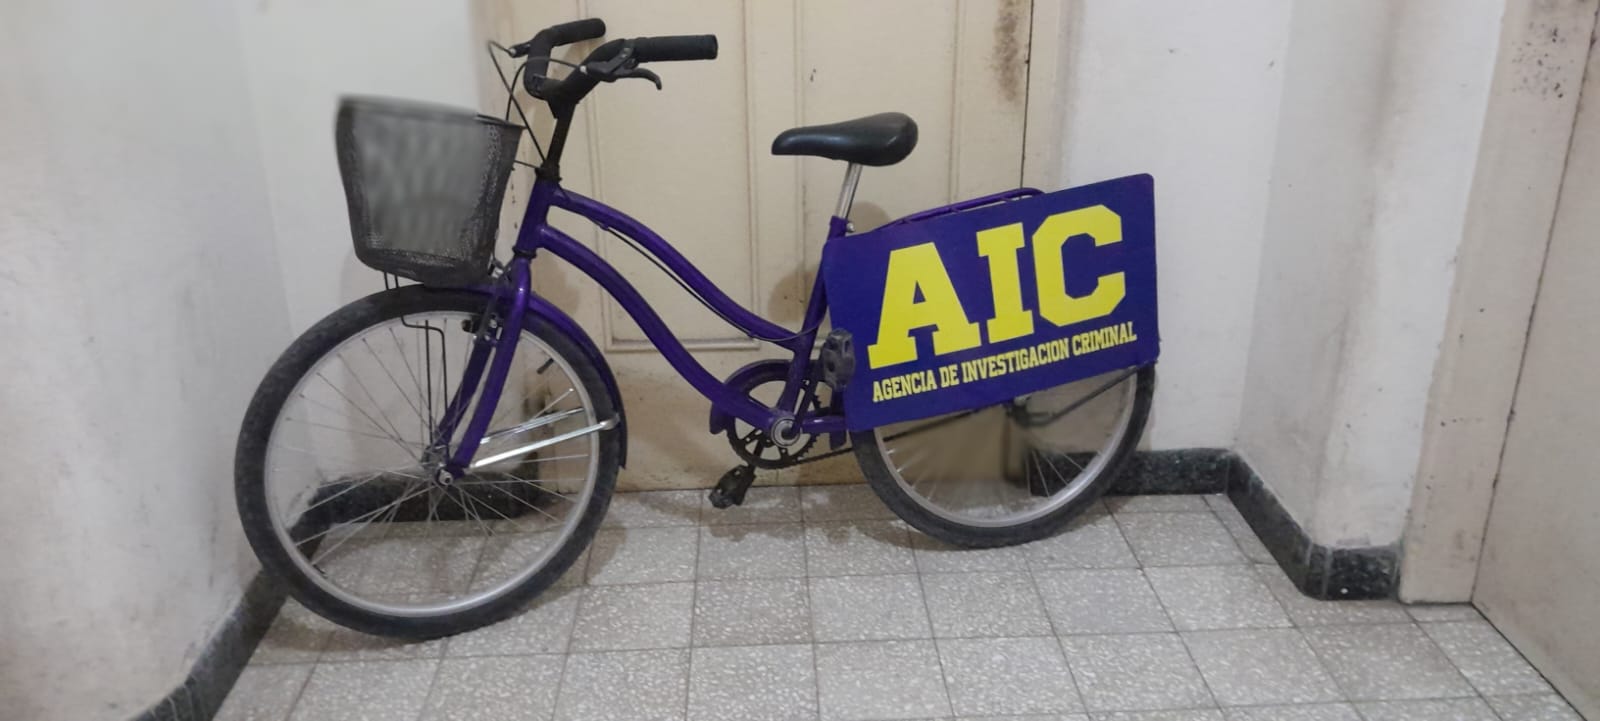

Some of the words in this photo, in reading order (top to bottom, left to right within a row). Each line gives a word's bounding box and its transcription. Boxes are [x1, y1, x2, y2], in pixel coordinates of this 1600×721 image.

[867, 204, 1127, 370] AIC
[872, 370, 938, 403] AGENCIA
[940, 364, 960, 389] DE
[962, 338, 1069, 383] INVESTIGACION
[1072, 321, 1137, 357] CRIMINAL
